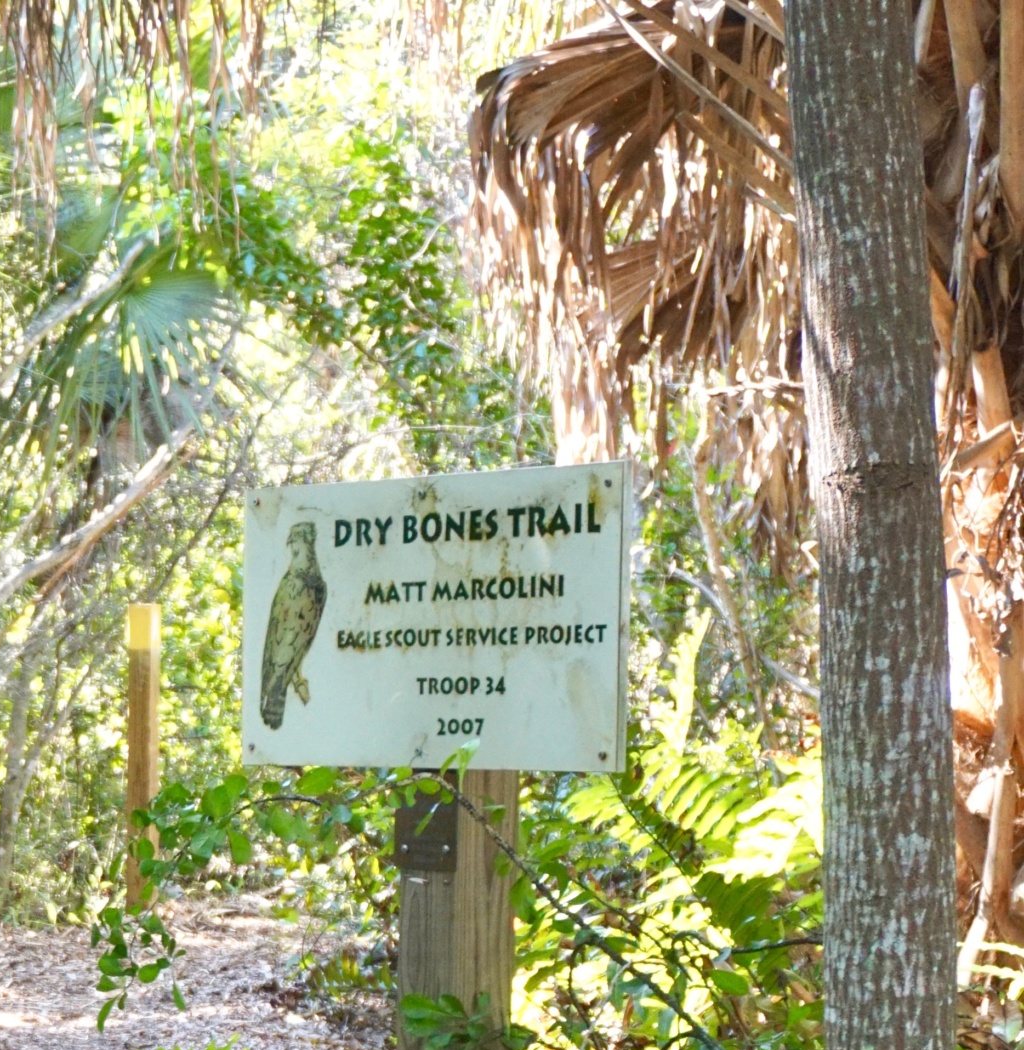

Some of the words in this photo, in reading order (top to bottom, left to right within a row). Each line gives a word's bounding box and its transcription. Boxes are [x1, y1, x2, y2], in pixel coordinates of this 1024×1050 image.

[335, 517, 393, 547] DRY
[403, 508, 499, 544] BONES
[508, 502, 602, 537] TRAIL
[365, 581, 426, 604] MATT
[432, 574, 565, 601] MARCOLINI
[337, 630, 381, 649] EAGLE
[385, 628, 441, 647] SCOUT
[446, 626, 518, 645] SERVICE
[525, 624, 607, 643] PROJECT
[417, 677, 481, 695] TROOP
[486, 676, 506, 695] 34
[437, 718, 484, 735] 2007
